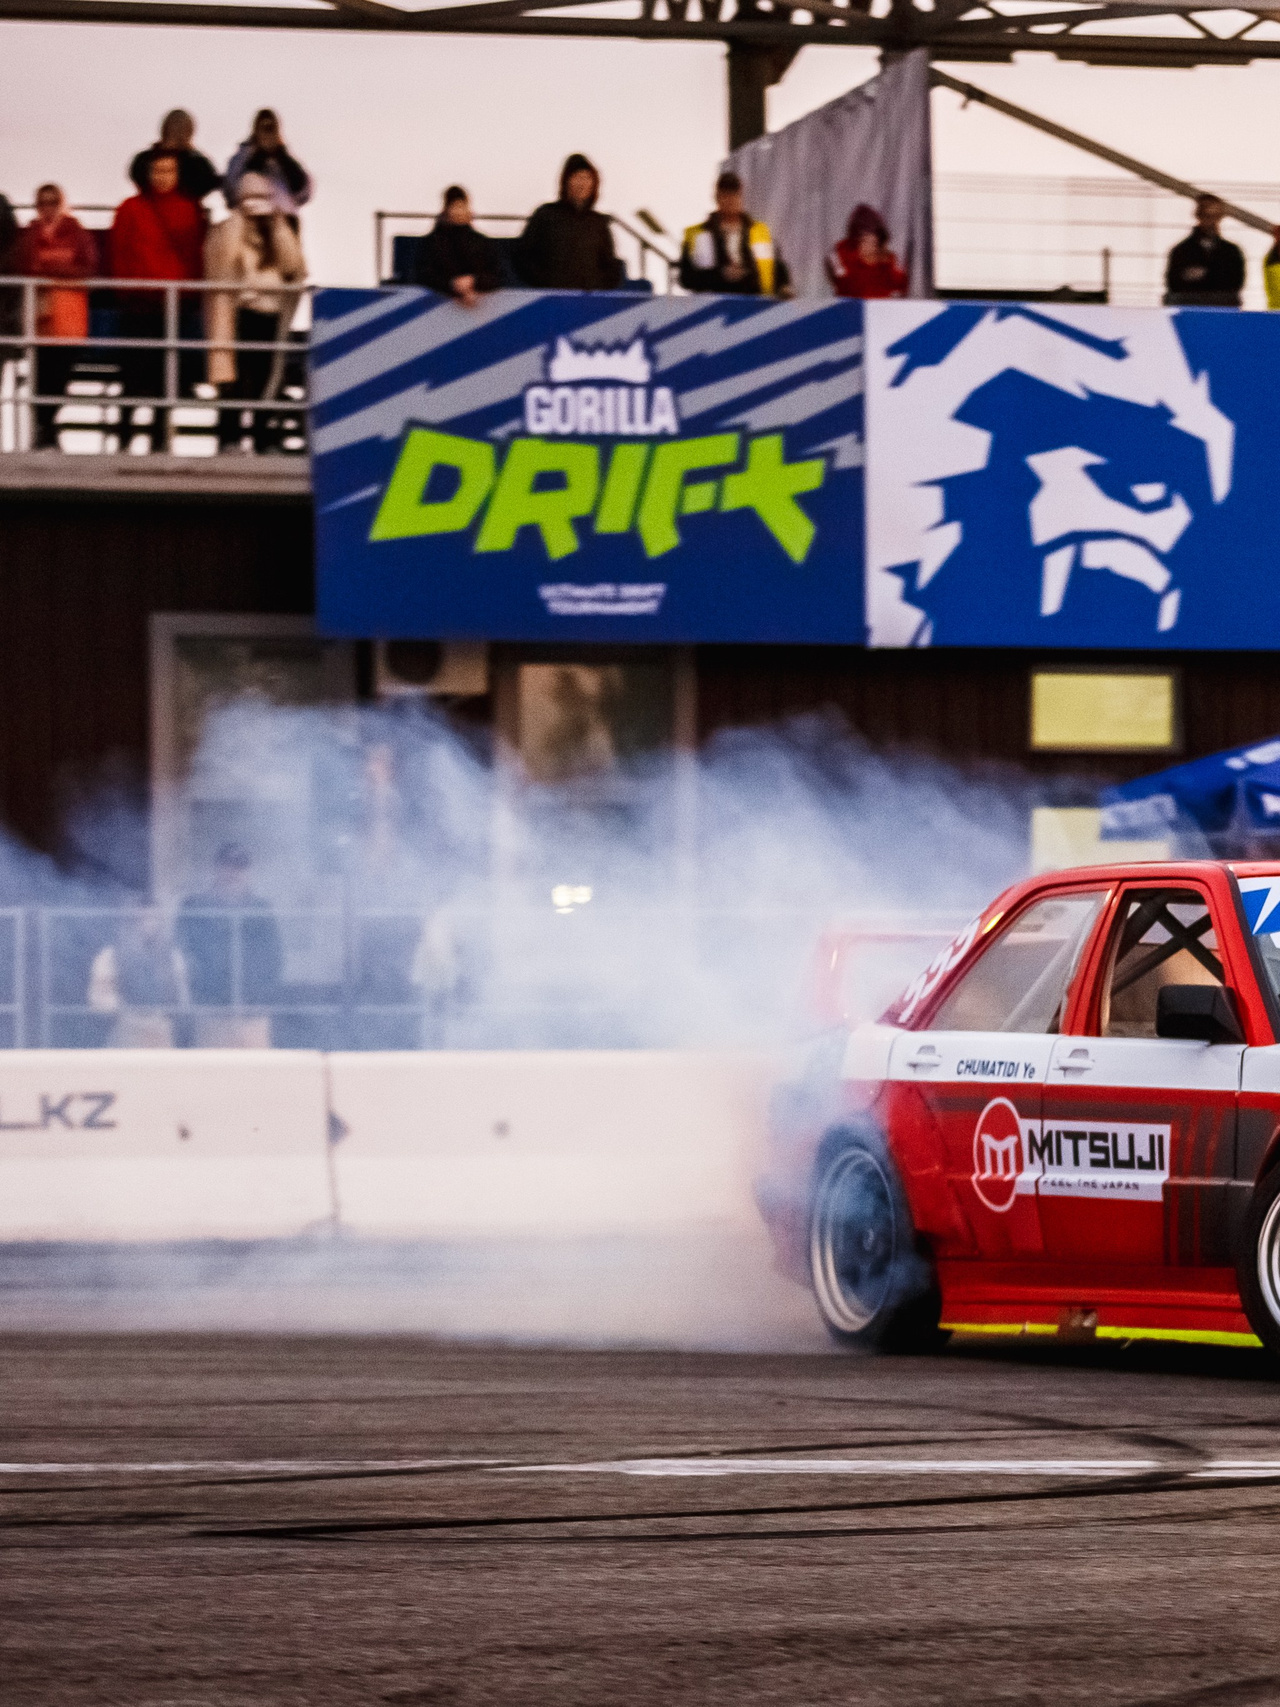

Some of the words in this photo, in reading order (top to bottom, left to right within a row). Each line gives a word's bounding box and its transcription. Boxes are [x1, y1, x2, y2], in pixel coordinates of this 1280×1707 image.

[525, 386, 679, 434] GORILLA
[368, 427, 826, 563] DRIFT
[956, 1059, 1021, 1079] CHUMATIDI
[1023, 1062, 1036, 1079] Ye
[1028, 1128, 1165, 1171] MITSUJI
